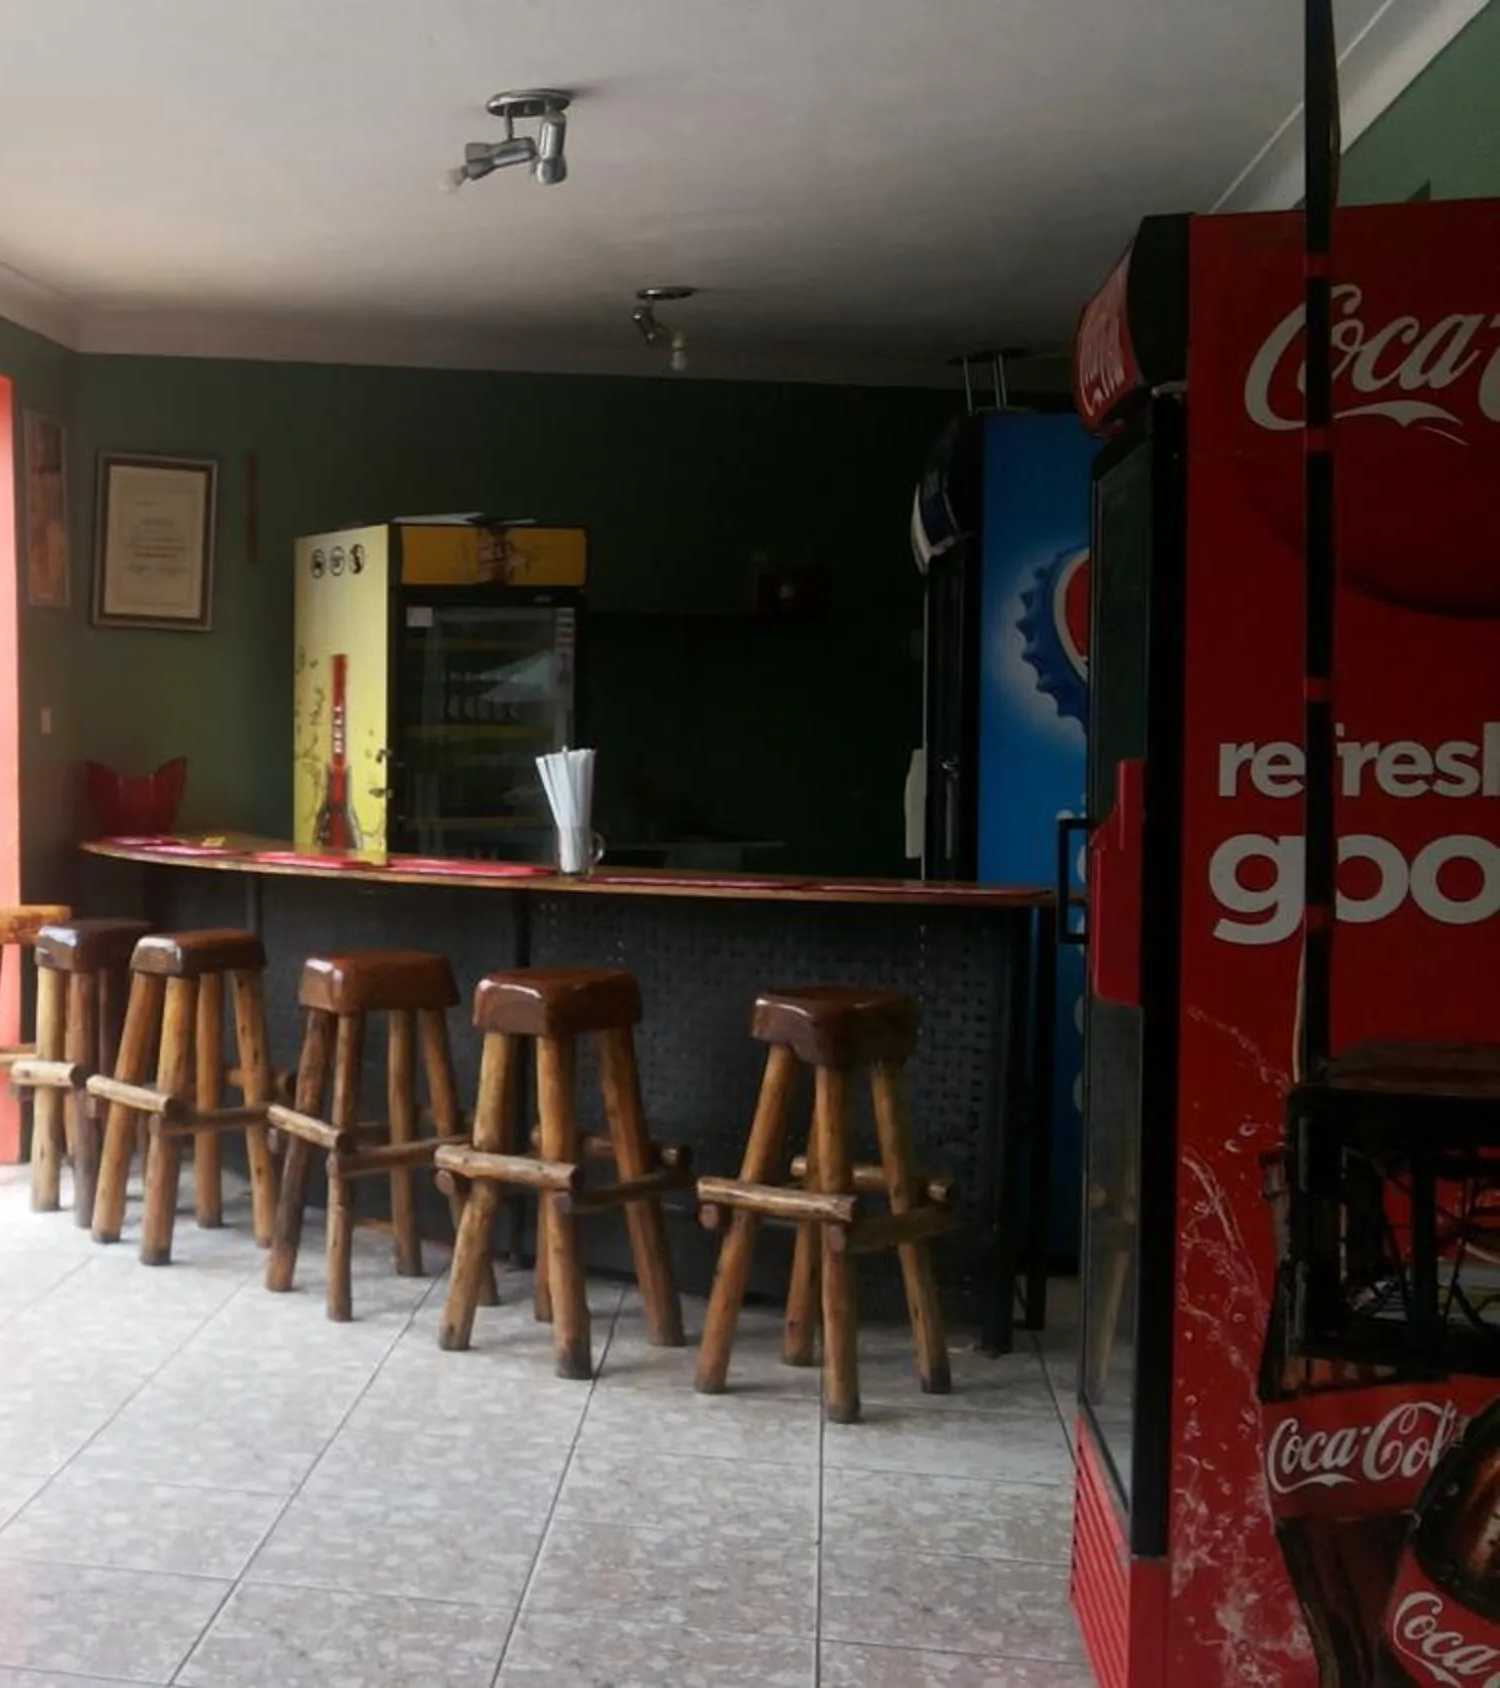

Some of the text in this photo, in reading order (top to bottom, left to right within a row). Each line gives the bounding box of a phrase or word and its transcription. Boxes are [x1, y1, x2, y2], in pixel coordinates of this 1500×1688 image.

[1244, 283, 1500, 433] Coca-
[1218, 721, 1500, 798] reres
[1208, 833, 1500, 945] goo
[1268, 1400, 1458, 1493] Coca-Col
